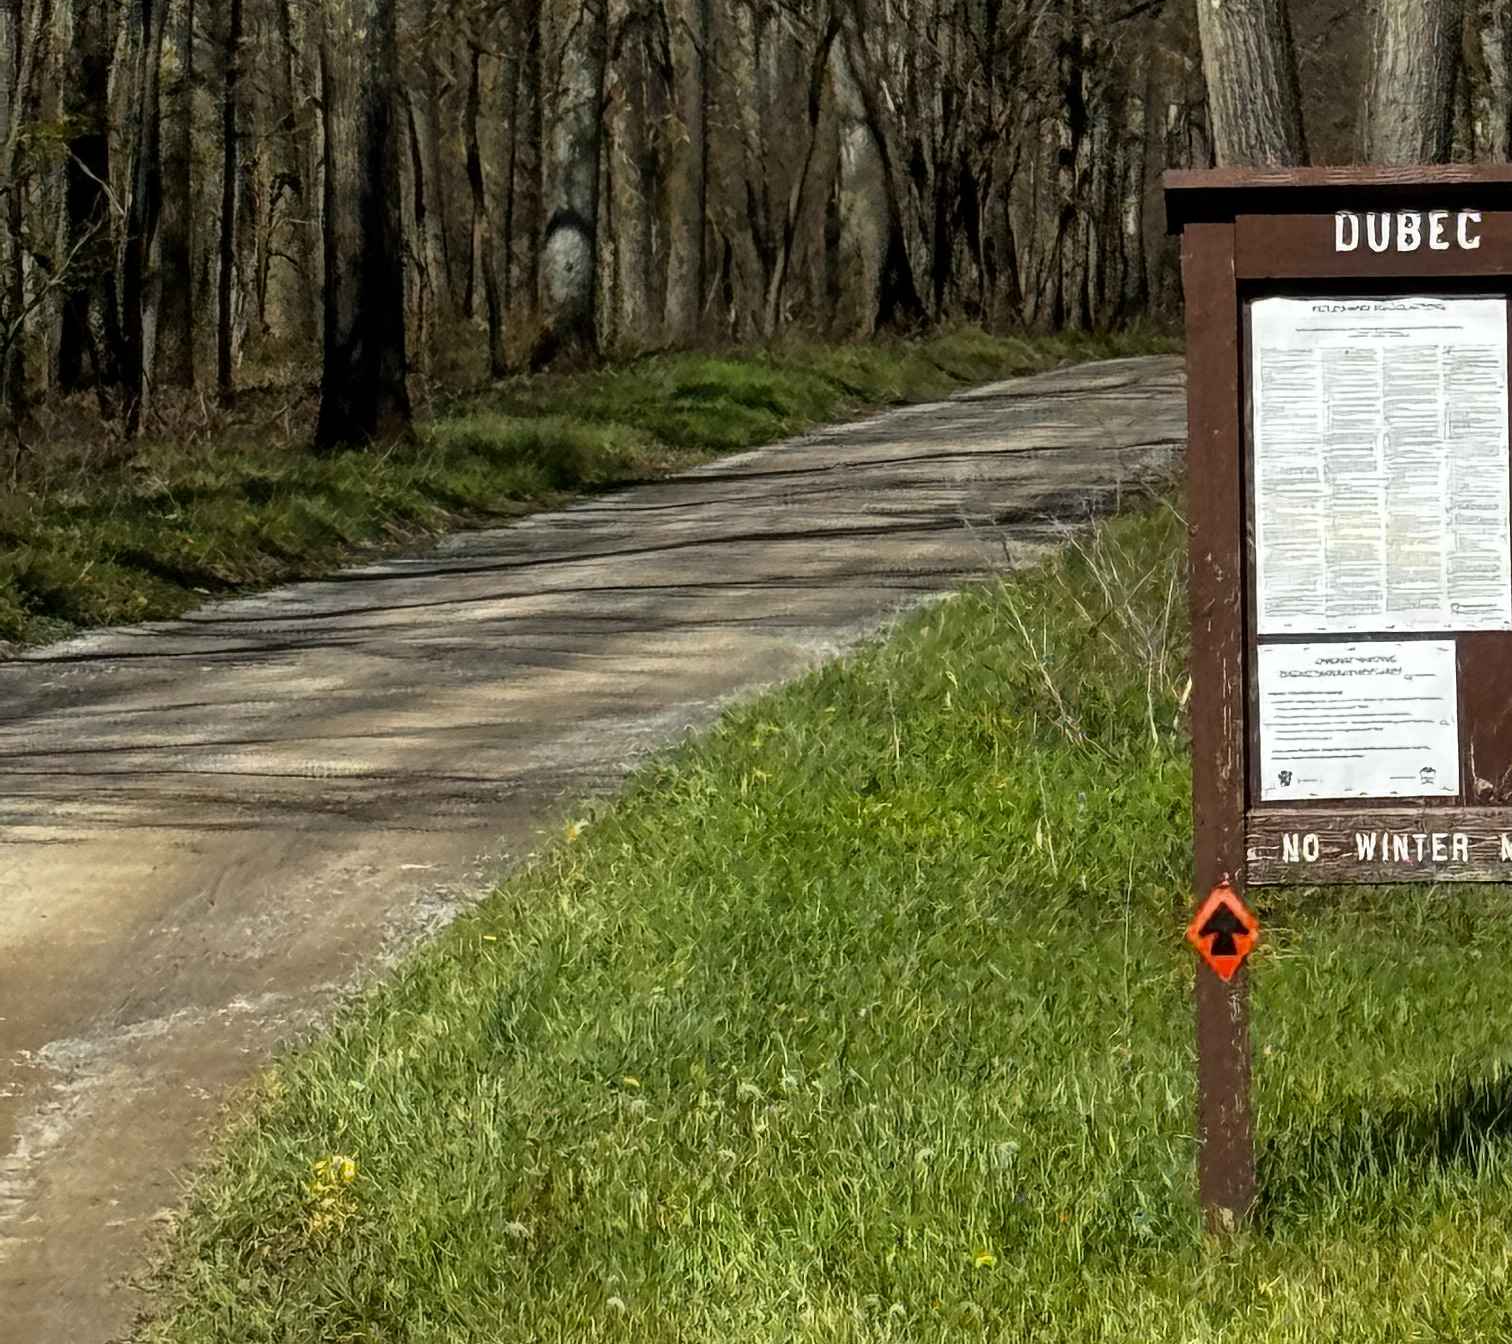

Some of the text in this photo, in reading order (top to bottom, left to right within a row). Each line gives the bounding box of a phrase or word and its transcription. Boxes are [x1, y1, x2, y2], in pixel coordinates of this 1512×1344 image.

[1335, 209, 1482, 253] DUBEC
[1282, 833, 1320, 863] NO
[1356, 832, 1470, 863] WINTER
